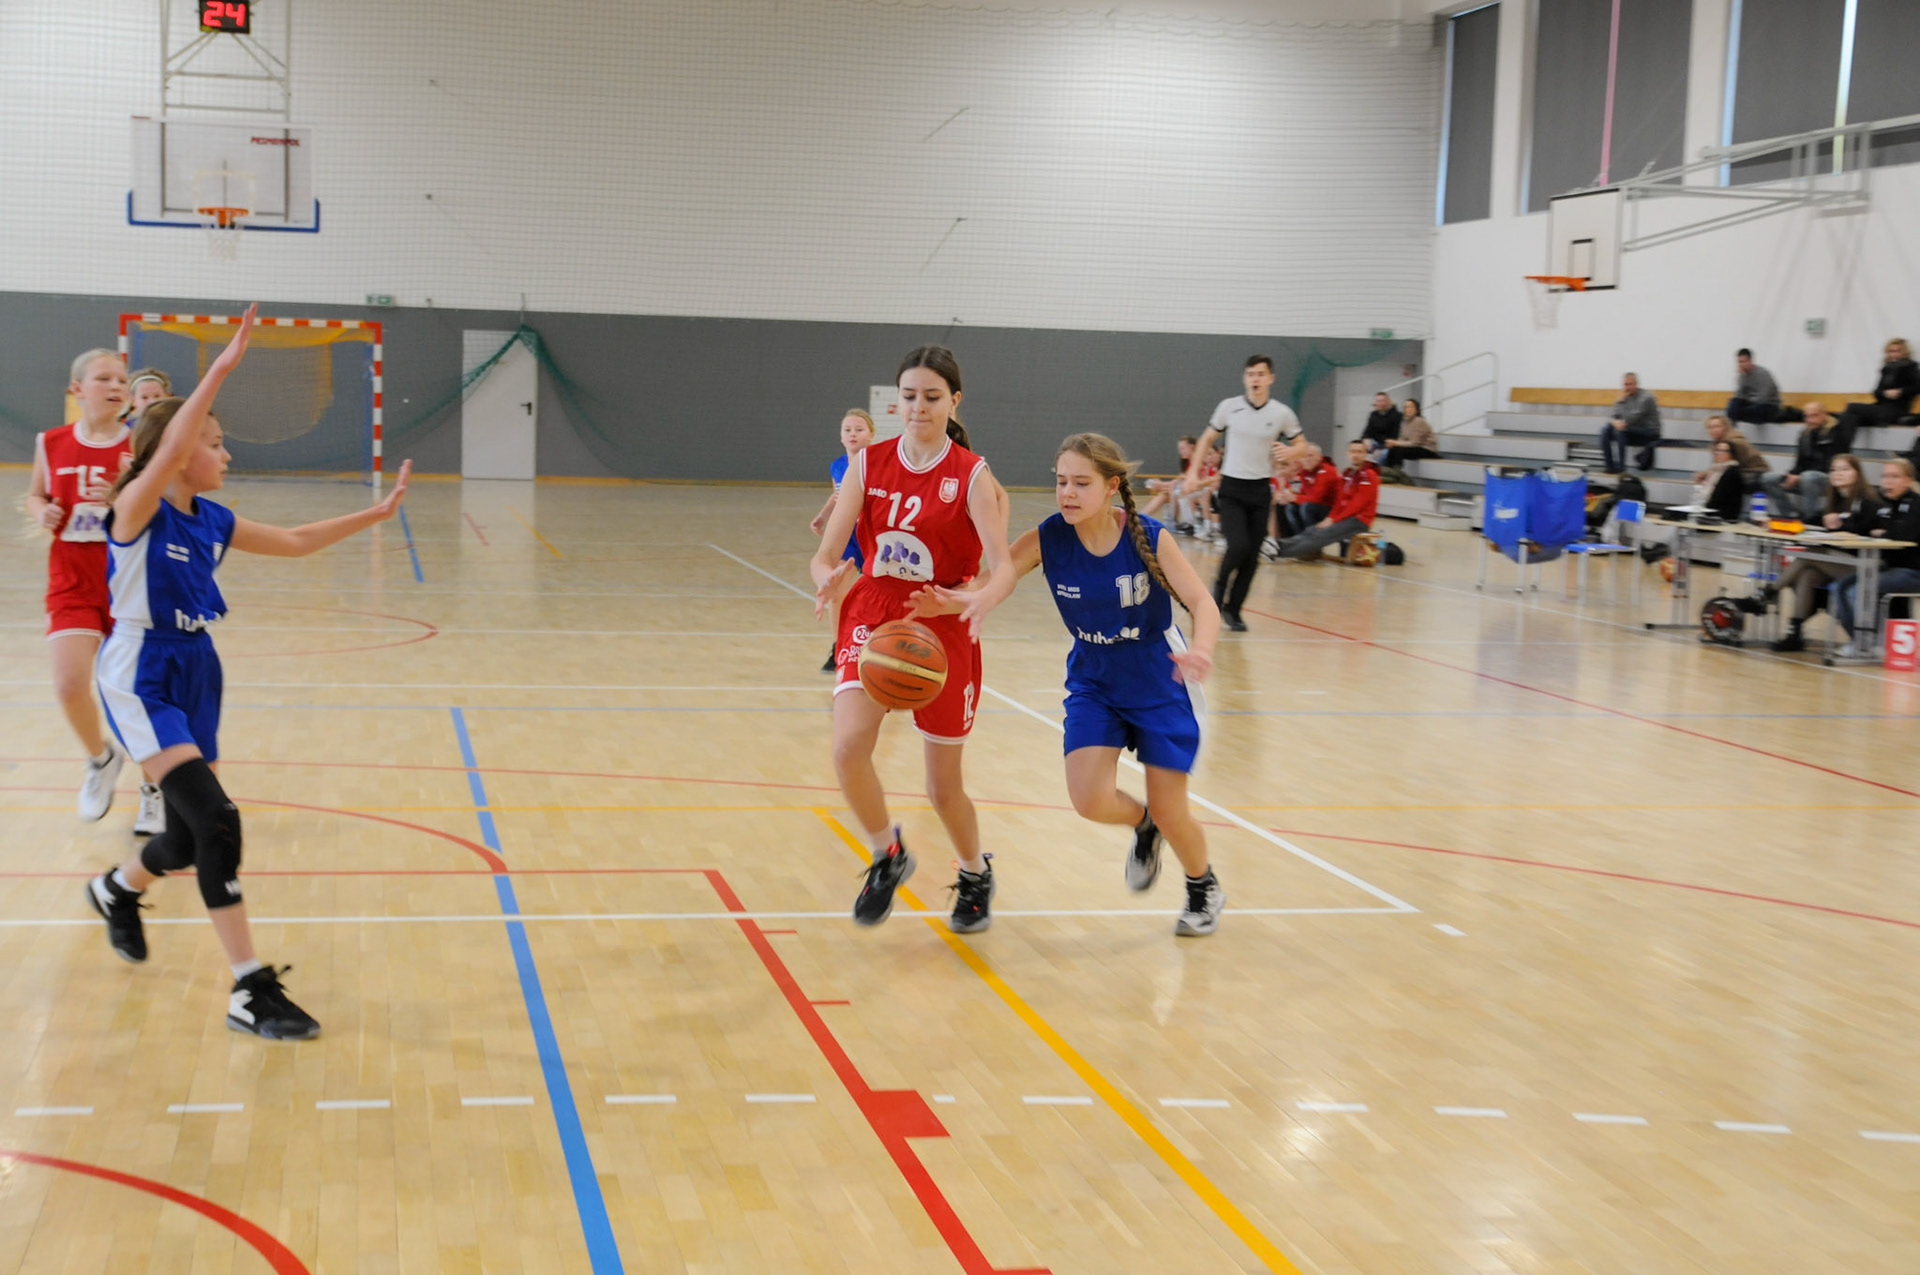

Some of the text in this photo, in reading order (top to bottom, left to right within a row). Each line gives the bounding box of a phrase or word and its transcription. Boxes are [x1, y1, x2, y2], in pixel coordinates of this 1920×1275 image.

[203, 1, 246, 27] 24
[867, 487, 888, 499] JAKO
[887, 491, 922, 532] 12
[1115, 571, 1151, 609] 18
[1891, 624, 1916, 655] 5
[963, 680, 975, 722] 12
